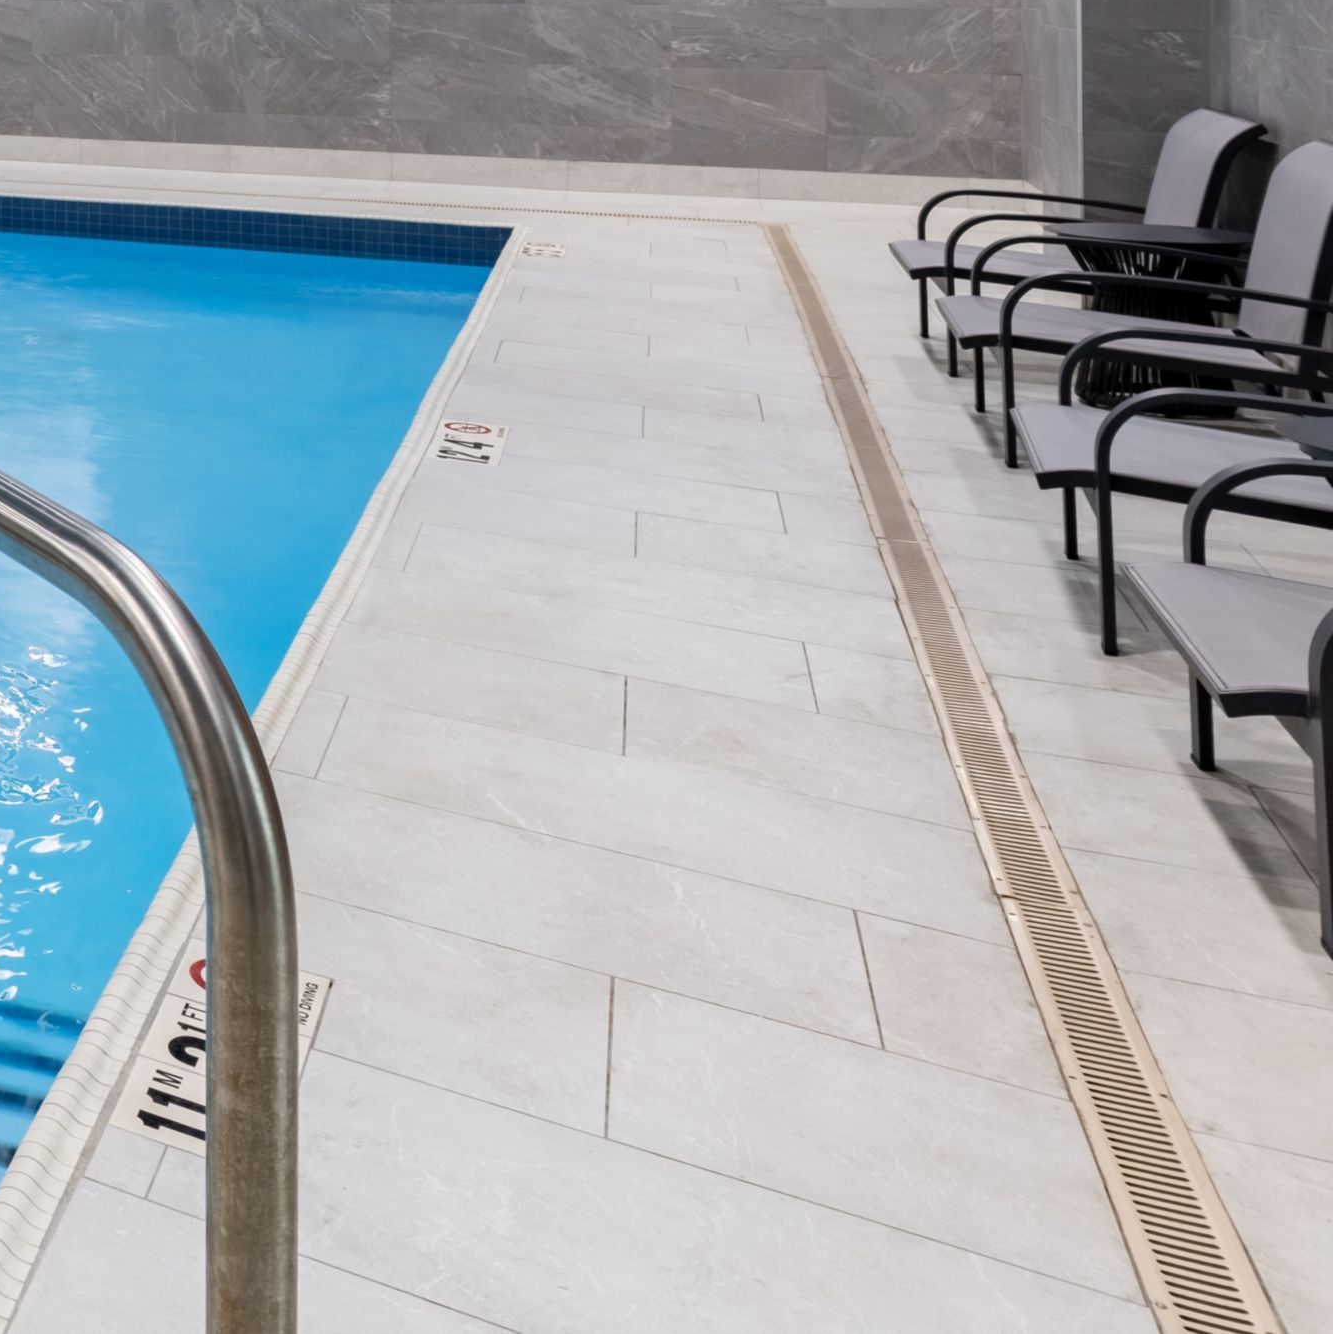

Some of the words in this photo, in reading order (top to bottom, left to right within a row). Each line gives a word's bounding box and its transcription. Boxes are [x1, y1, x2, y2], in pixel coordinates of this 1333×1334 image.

[443, 439, 494, 450] 4
[182, 1003, 206, 1022] FT
[299, 1002, 307, 1025] NO
[303, 982, 318, 1012] DIVING
[153, 1069, 183, 1089] M
